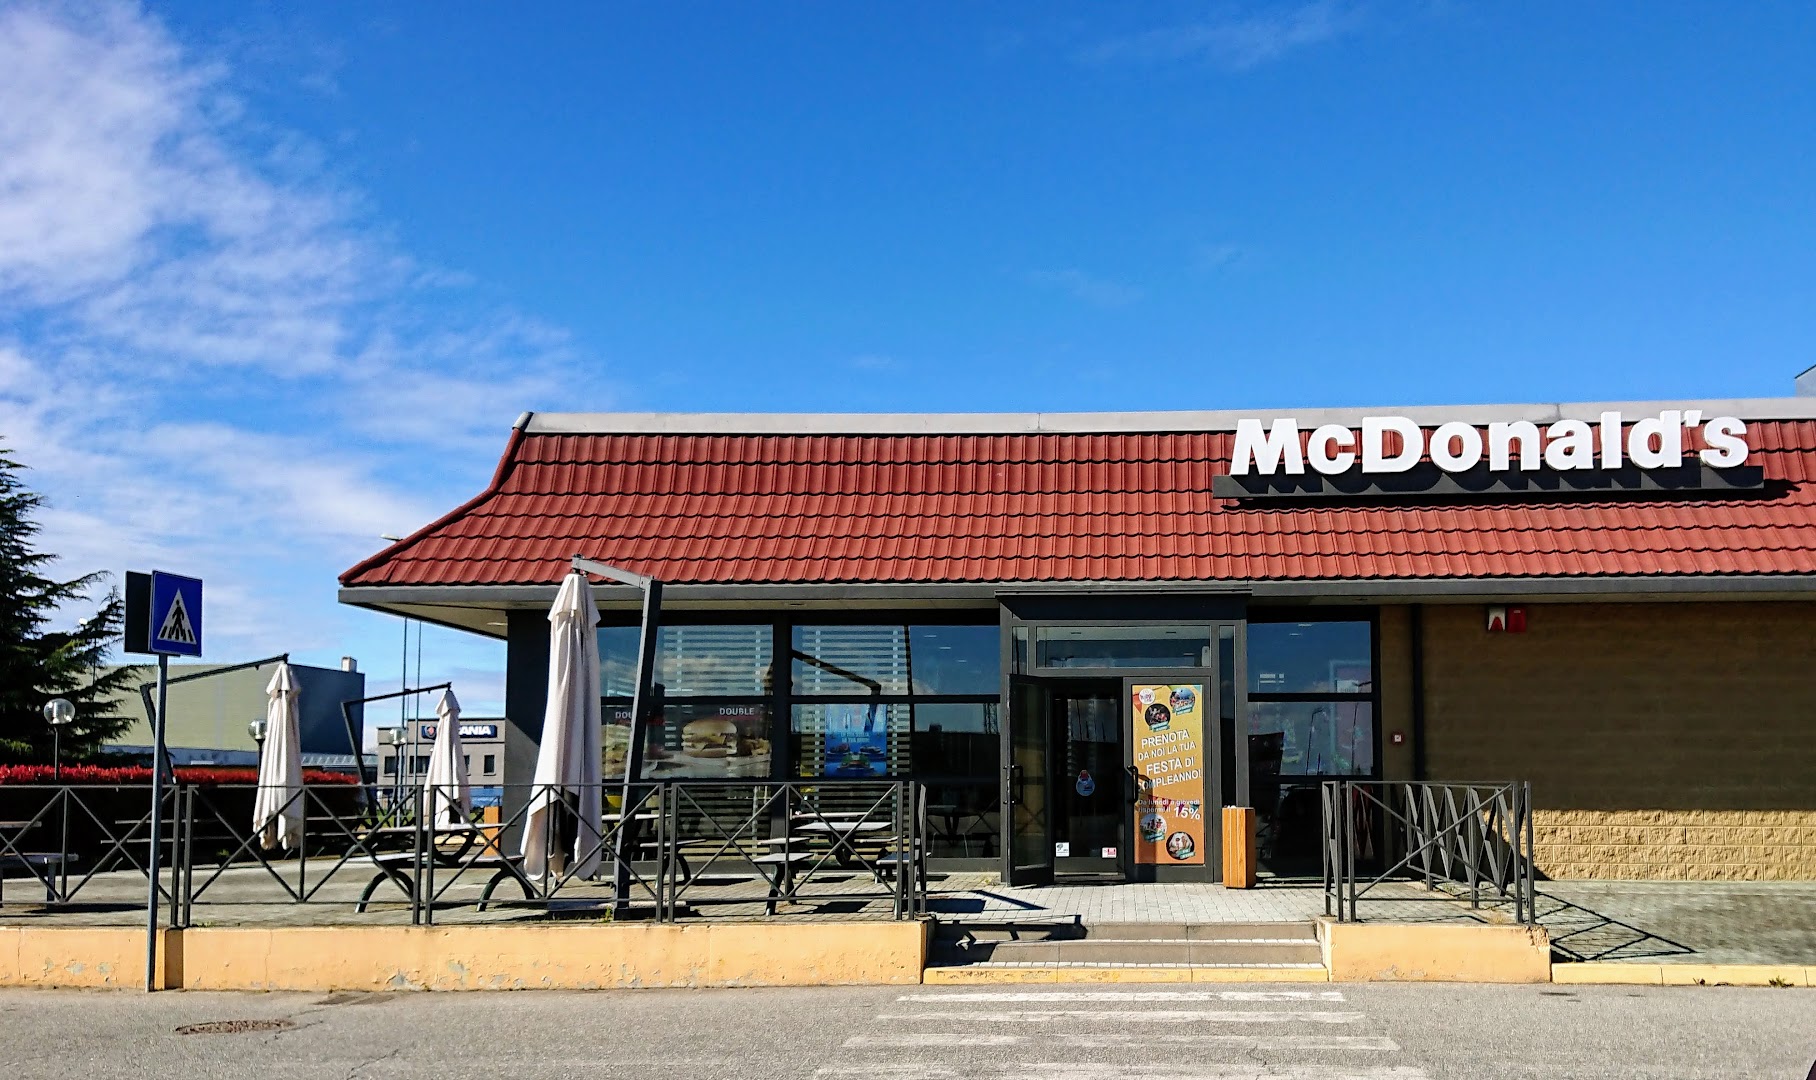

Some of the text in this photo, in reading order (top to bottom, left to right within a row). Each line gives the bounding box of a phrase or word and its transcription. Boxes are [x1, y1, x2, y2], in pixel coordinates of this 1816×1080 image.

[1230, 410, 1749, 475] McDonald's
[719, 707, 755, 716] DOUBLE
[458, 725, 492, 735] ANIA
[1141, 729, 1189, 749] PRENOTA
[1138, 741, 1196, 761] DA NOI LA TUA
[1146, 757, 1195, 776] FESTA DI
[1174, 806, 1201, 820] 15%
